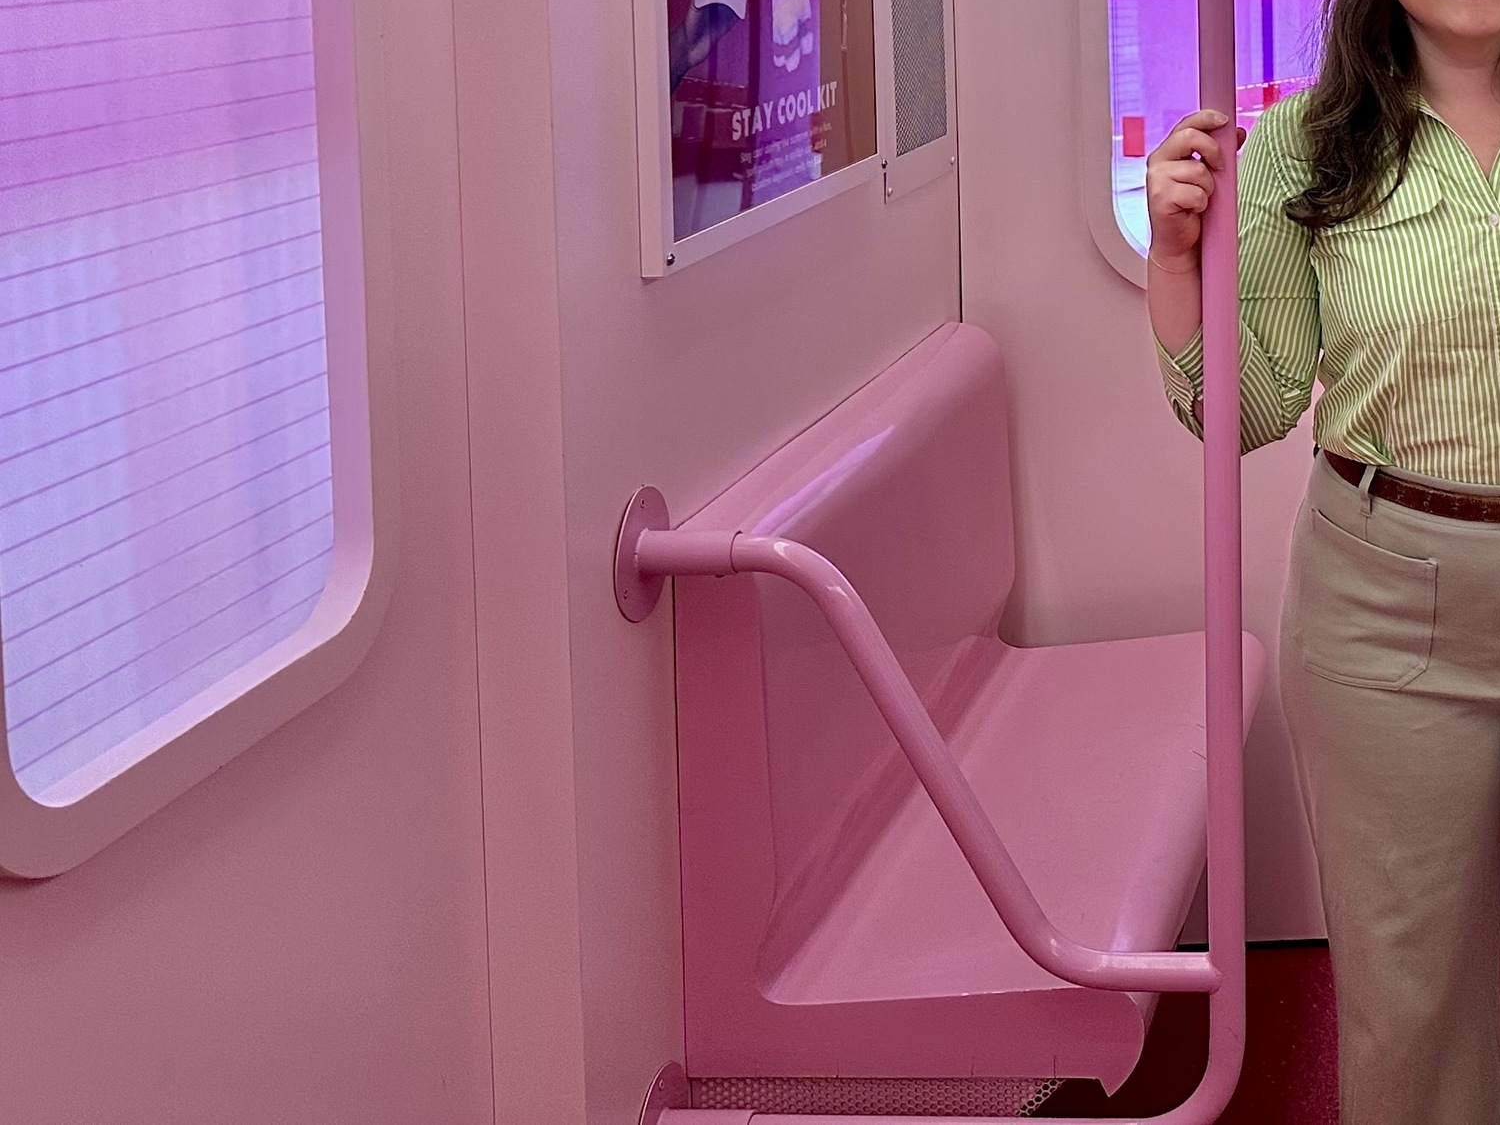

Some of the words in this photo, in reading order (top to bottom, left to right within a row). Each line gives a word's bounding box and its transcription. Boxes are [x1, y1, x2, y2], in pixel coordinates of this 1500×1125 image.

[732, 100, 774, 141] STAY
[777, 89, 814, 125] COOL
[816, 81, 837, 112] KIT
